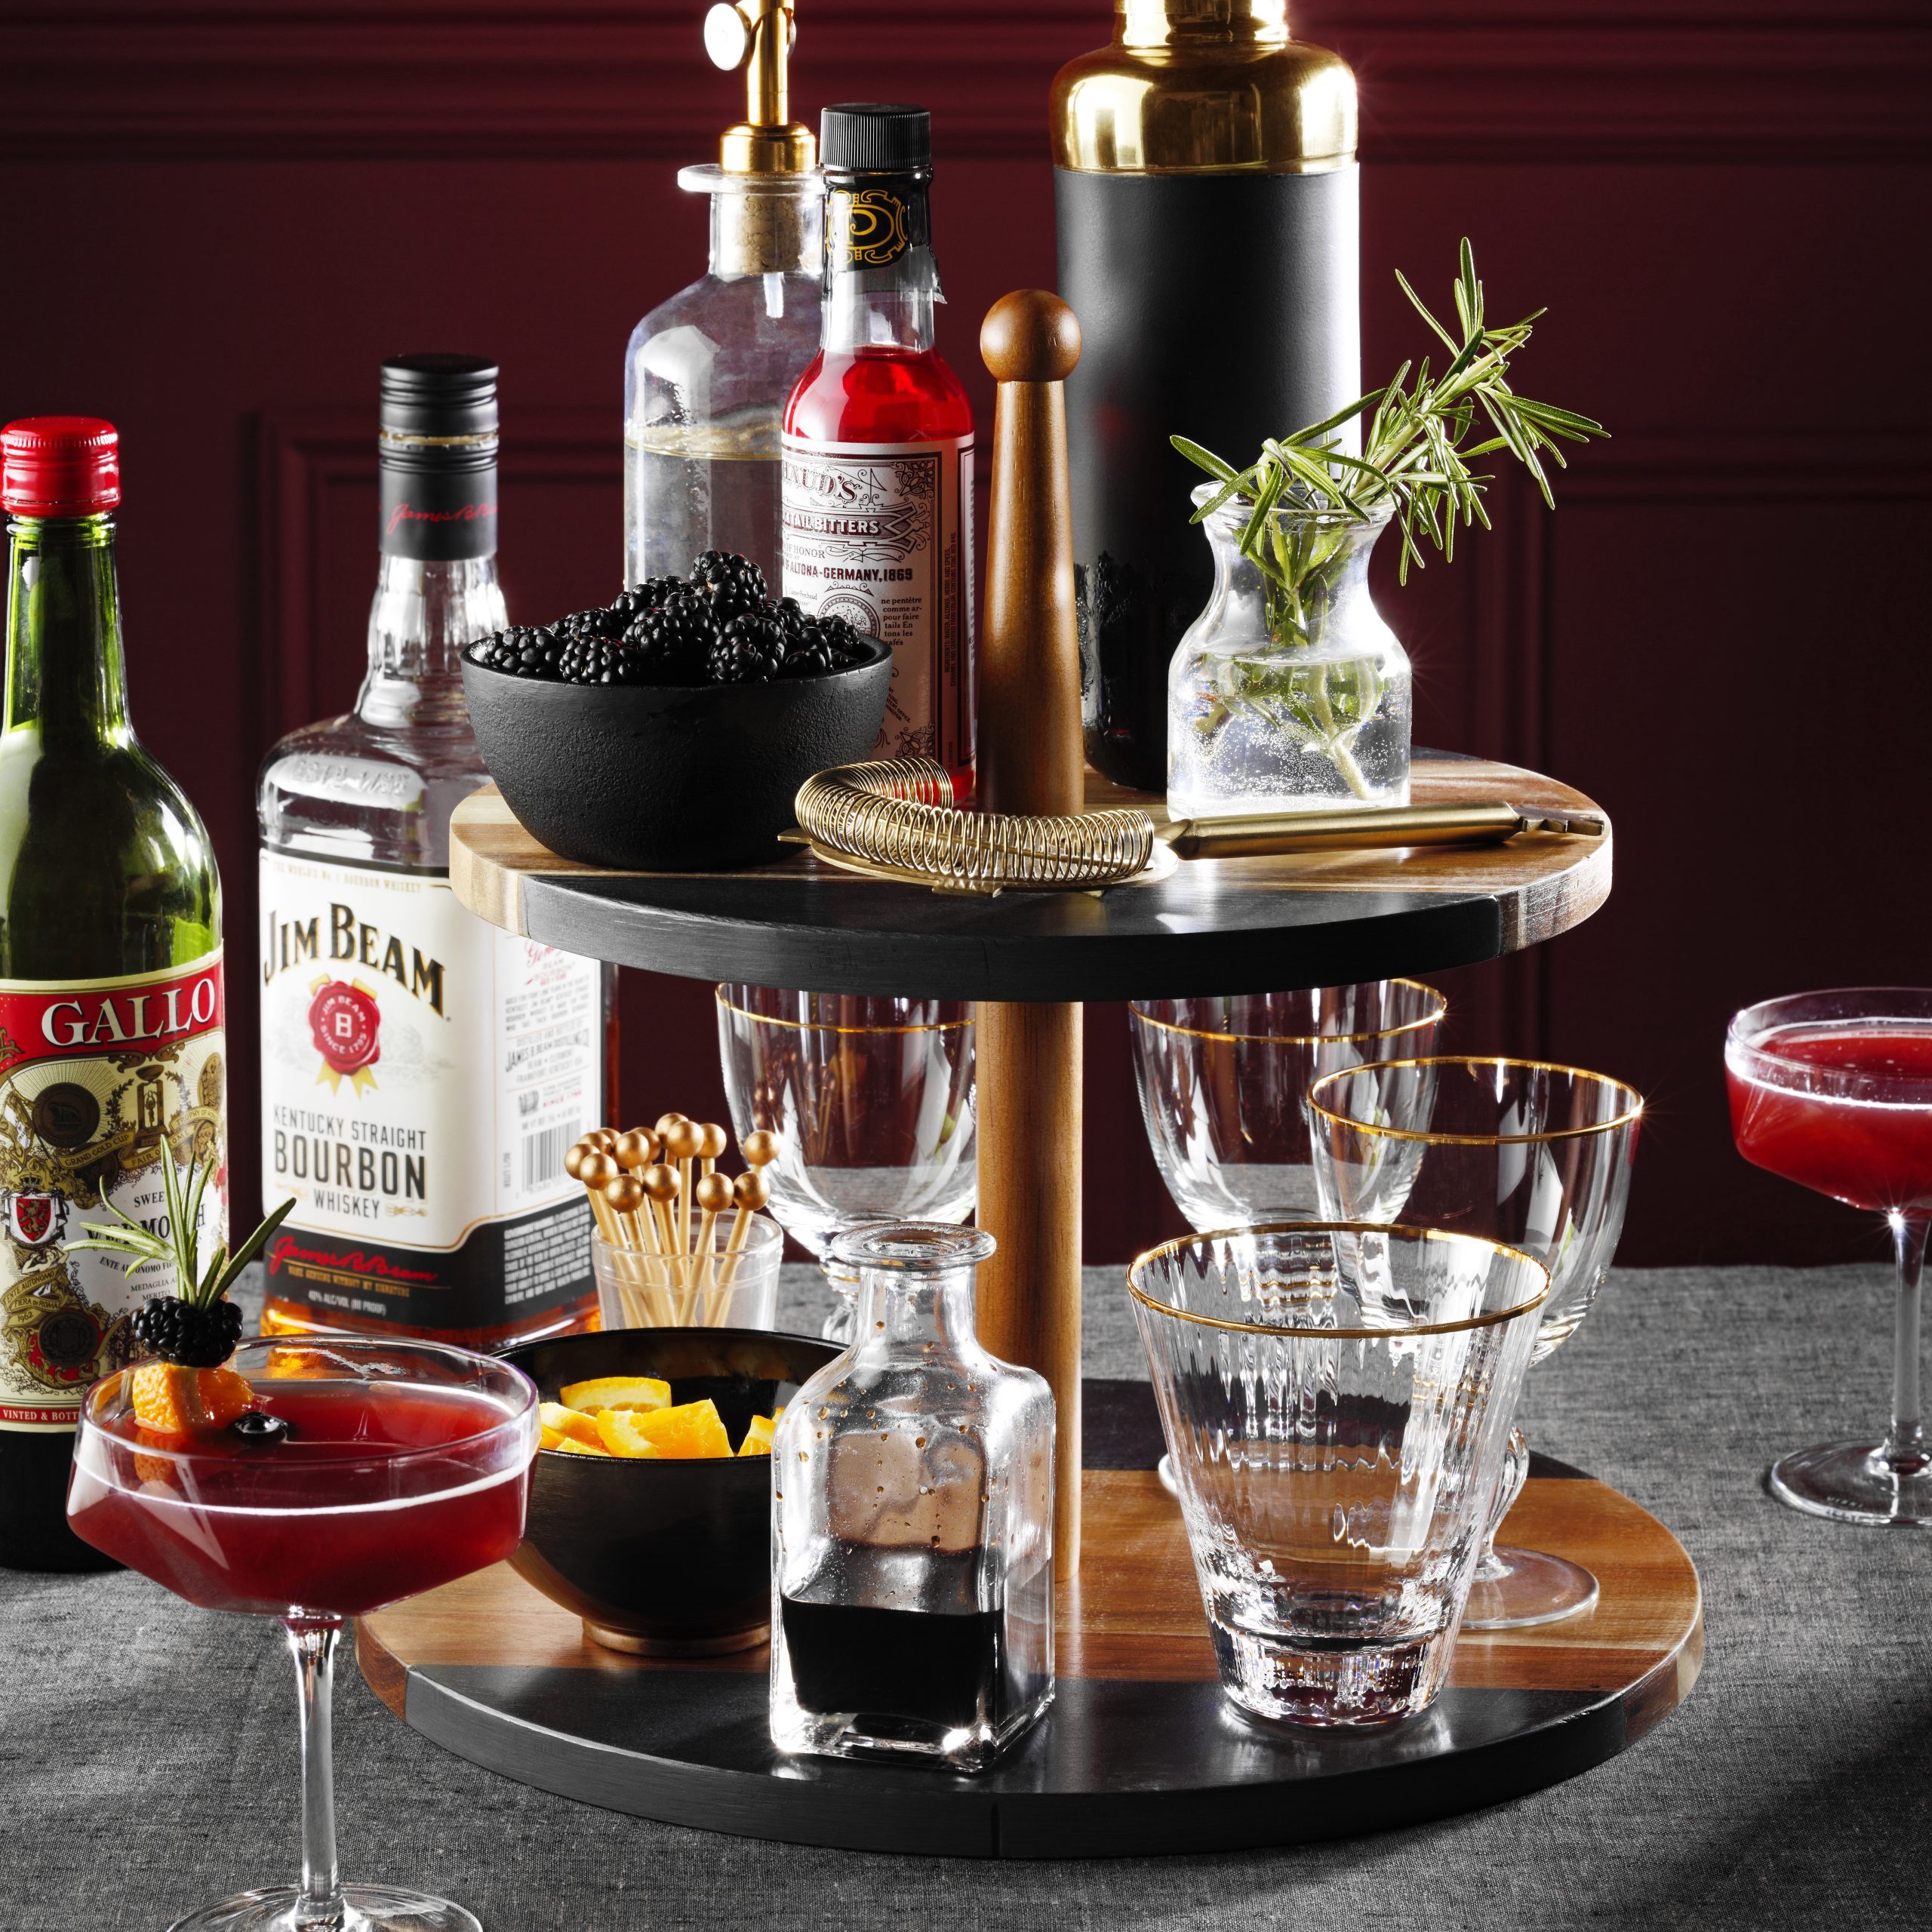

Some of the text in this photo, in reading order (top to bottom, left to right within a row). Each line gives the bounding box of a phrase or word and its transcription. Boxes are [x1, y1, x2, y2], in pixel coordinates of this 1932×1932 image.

[814, 516, 882, 537] BITTERS
[793, 545, 826, 558] HONOR
[264, 909, 319, 987] JIM
[330, 903, 445, 1018] BEAM
[42, 978, 216, 1047] GALLO
[321, 995, 366, 1022] JIM BEAM
[335, 1012, 352, 1038] B
[320, 1025, 346, 1054] SINCE
[273, 1104, 426, 1151] KENTUCKY STRAIGHT
[65, 1153, 91, 1166] GRAND
[113, 1134, 130, 1145] CUP
[131, 1153, 153, 1166] FAIR
[274, 1129, 426, 1202] BOURBON
[134, 1191, 165, 1208] SWEE
[314, 1188, 380, 1220] WHISKEY
[100, 1256, 119, 1270] ENTE
[121, 1263, 161, 1274] AONOMO
[6, 1271, 54, 1303] ENTE AUTONOMO
[131, 1279, 169, 1292] MEDAGLIA
[142, 1290, 171, 1301] MERITO
[14, 1298, 32, 1307] FIERA
[38, 1300, 58, 1309] ROMA
[17, 1312, 34, 1323] 1962
[2, 1409, 37, 1420] VINTED
[41, 1412, 49, 1420] &
